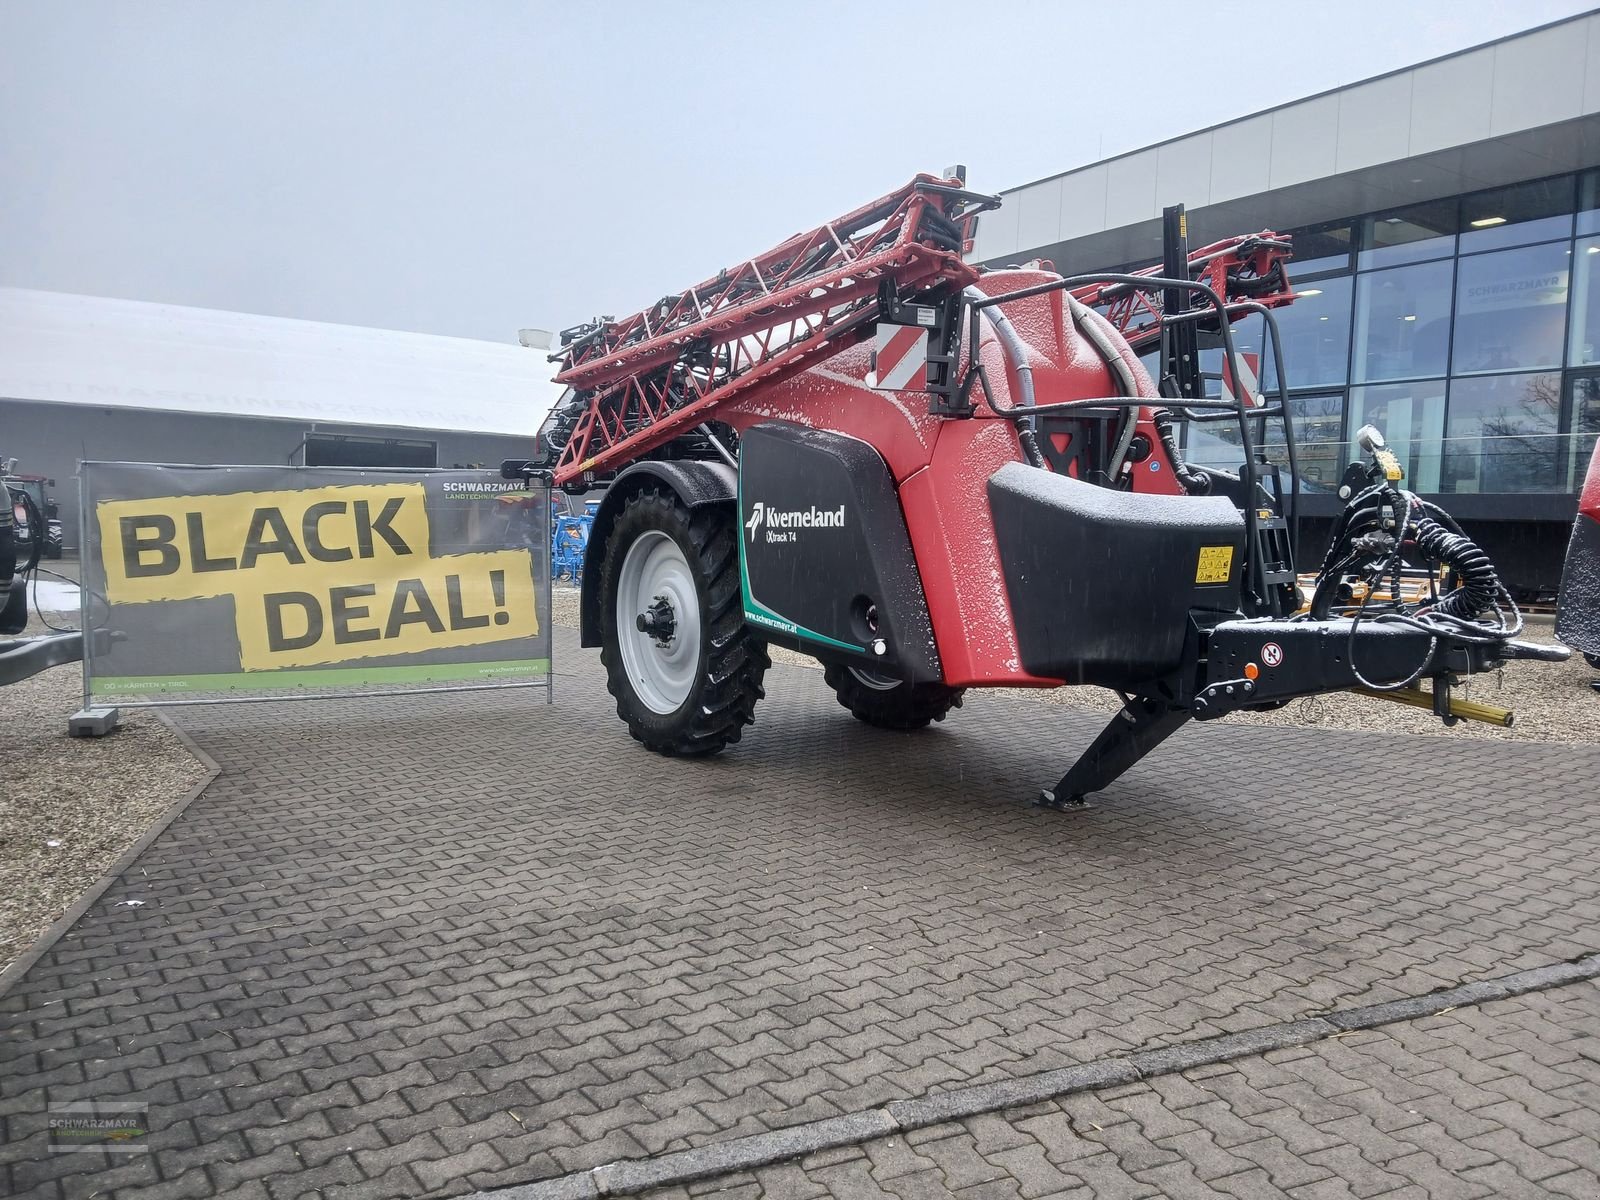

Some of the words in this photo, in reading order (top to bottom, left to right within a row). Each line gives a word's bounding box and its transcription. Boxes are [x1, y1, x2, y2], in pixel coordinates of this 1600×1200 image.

[1467, 276, 1560, 297] SCHWARZMAYR
[766, 505, 845, 528] Kverneland
[119, 497, 412, 579] BLACK
[788, 532, 797, 542] T4
[263, 569, 510, 652] DEAL!
[744, 611, 798, 634] www.schwarzmayr.at
